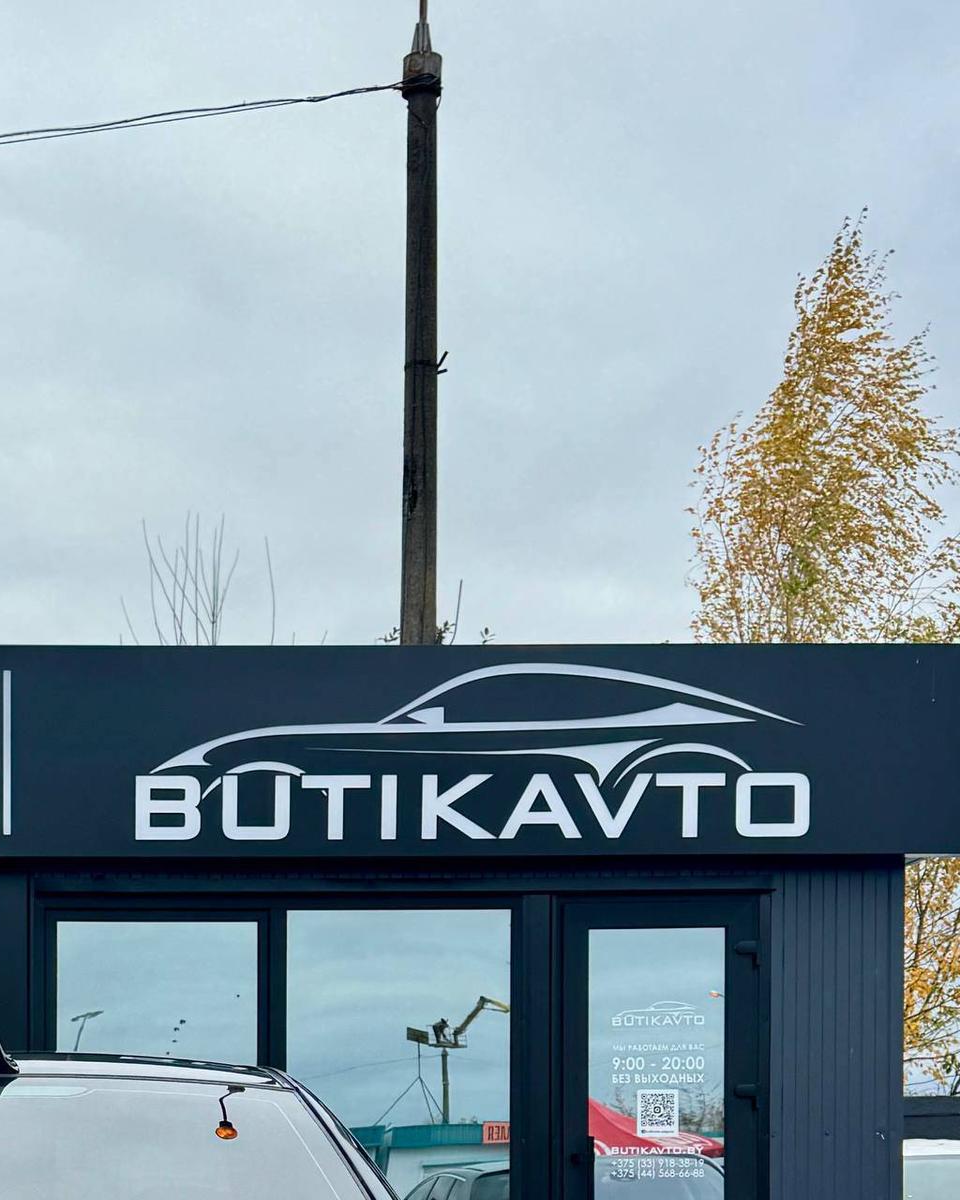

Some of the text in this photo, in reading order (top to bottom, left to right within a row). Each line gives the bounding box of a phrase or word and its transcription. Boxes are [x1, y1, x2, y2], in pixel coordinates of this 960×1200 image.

[134, 771, 811, 841] BUTIKAVTO
[611, 1014, 705, 1026] BUTIKAVTO
[612, 1043, 705, 1052] МЫ РАБОТАЕМ ДЛЯ ВАС
[612, 1056, 645, 1071] 9:00
[661, 1056, 705, 1070] 20:00
[612, 1073, 705, 1085] БЕЗ ВЫХОДНЫХ
[611, 1146, 705, 1155] BUTIKAVTO.BY
[611, 1158, 705, 1169] +375 (33) 918-38-19
[611, 1168, 705, 1179] +375 (44) 568-66-88
